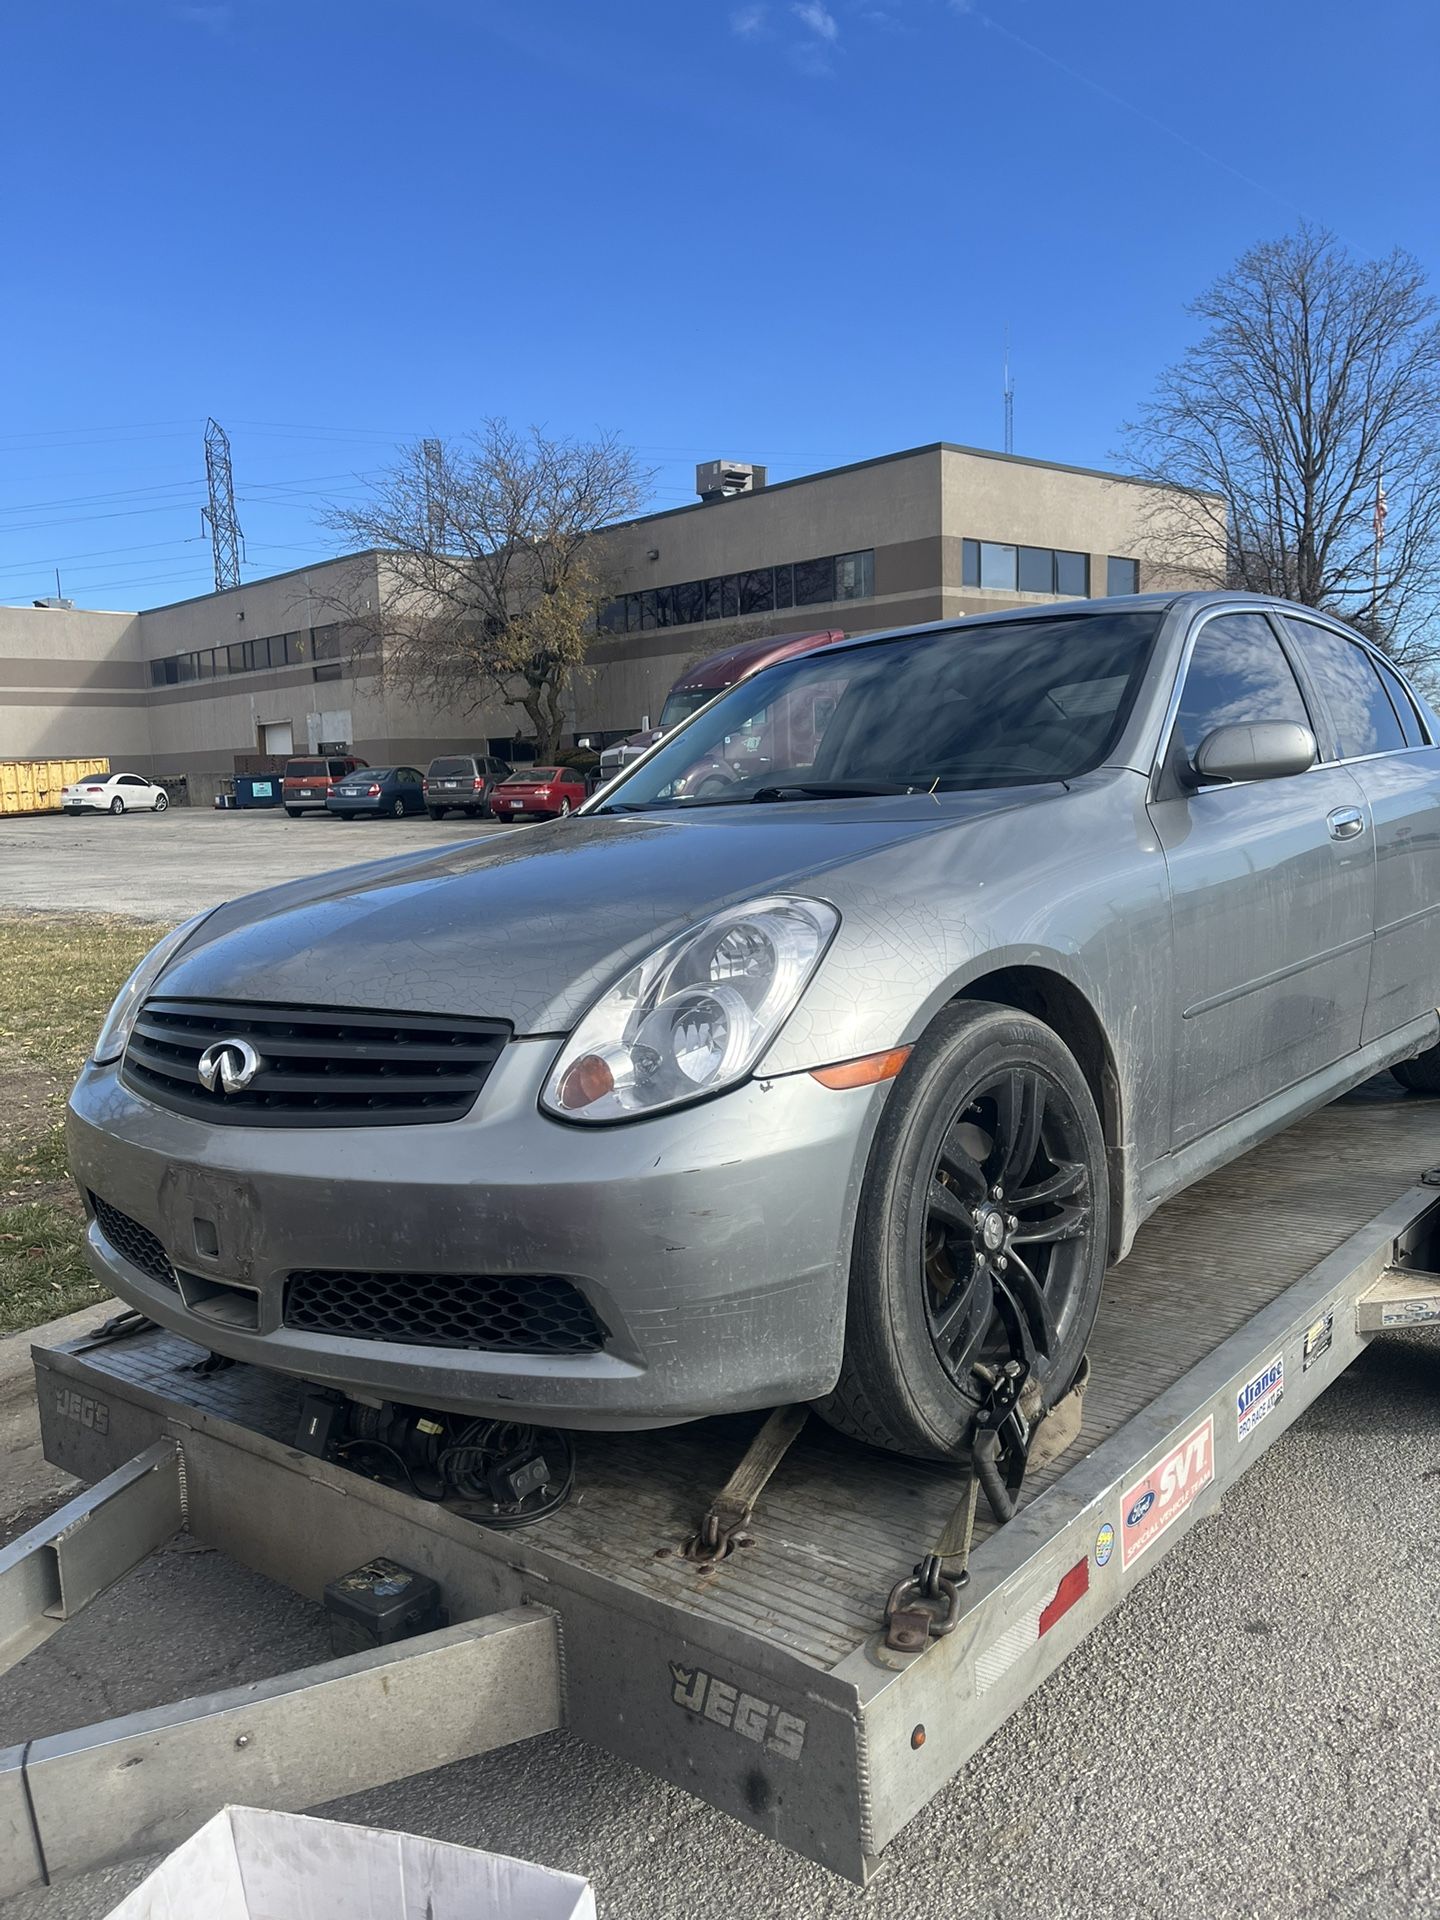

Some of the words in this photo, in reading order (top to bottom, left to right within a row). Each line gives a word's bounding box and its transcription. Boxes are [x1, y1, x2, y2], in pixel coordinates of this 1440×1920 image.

[56, 1387, 109, 1435] JEG'S
[1238, 1360, 1283, 1416] Strange
[1239, 1417, 1251, 1436] PRO
[1251, 1402, 1266, 1426] RACE
[1267, 1386, 1283, 1408] AXES
[1157, 1427, 1210, 1508] SVT
[1127, 1523, 1160, 1558] SPECIAL
[1159, 1489, 1190, 1525] VEHICLE
[1191, 1469, 1211, 1494] TEAM
[670, 1662, 807, 1760] JEG'S
